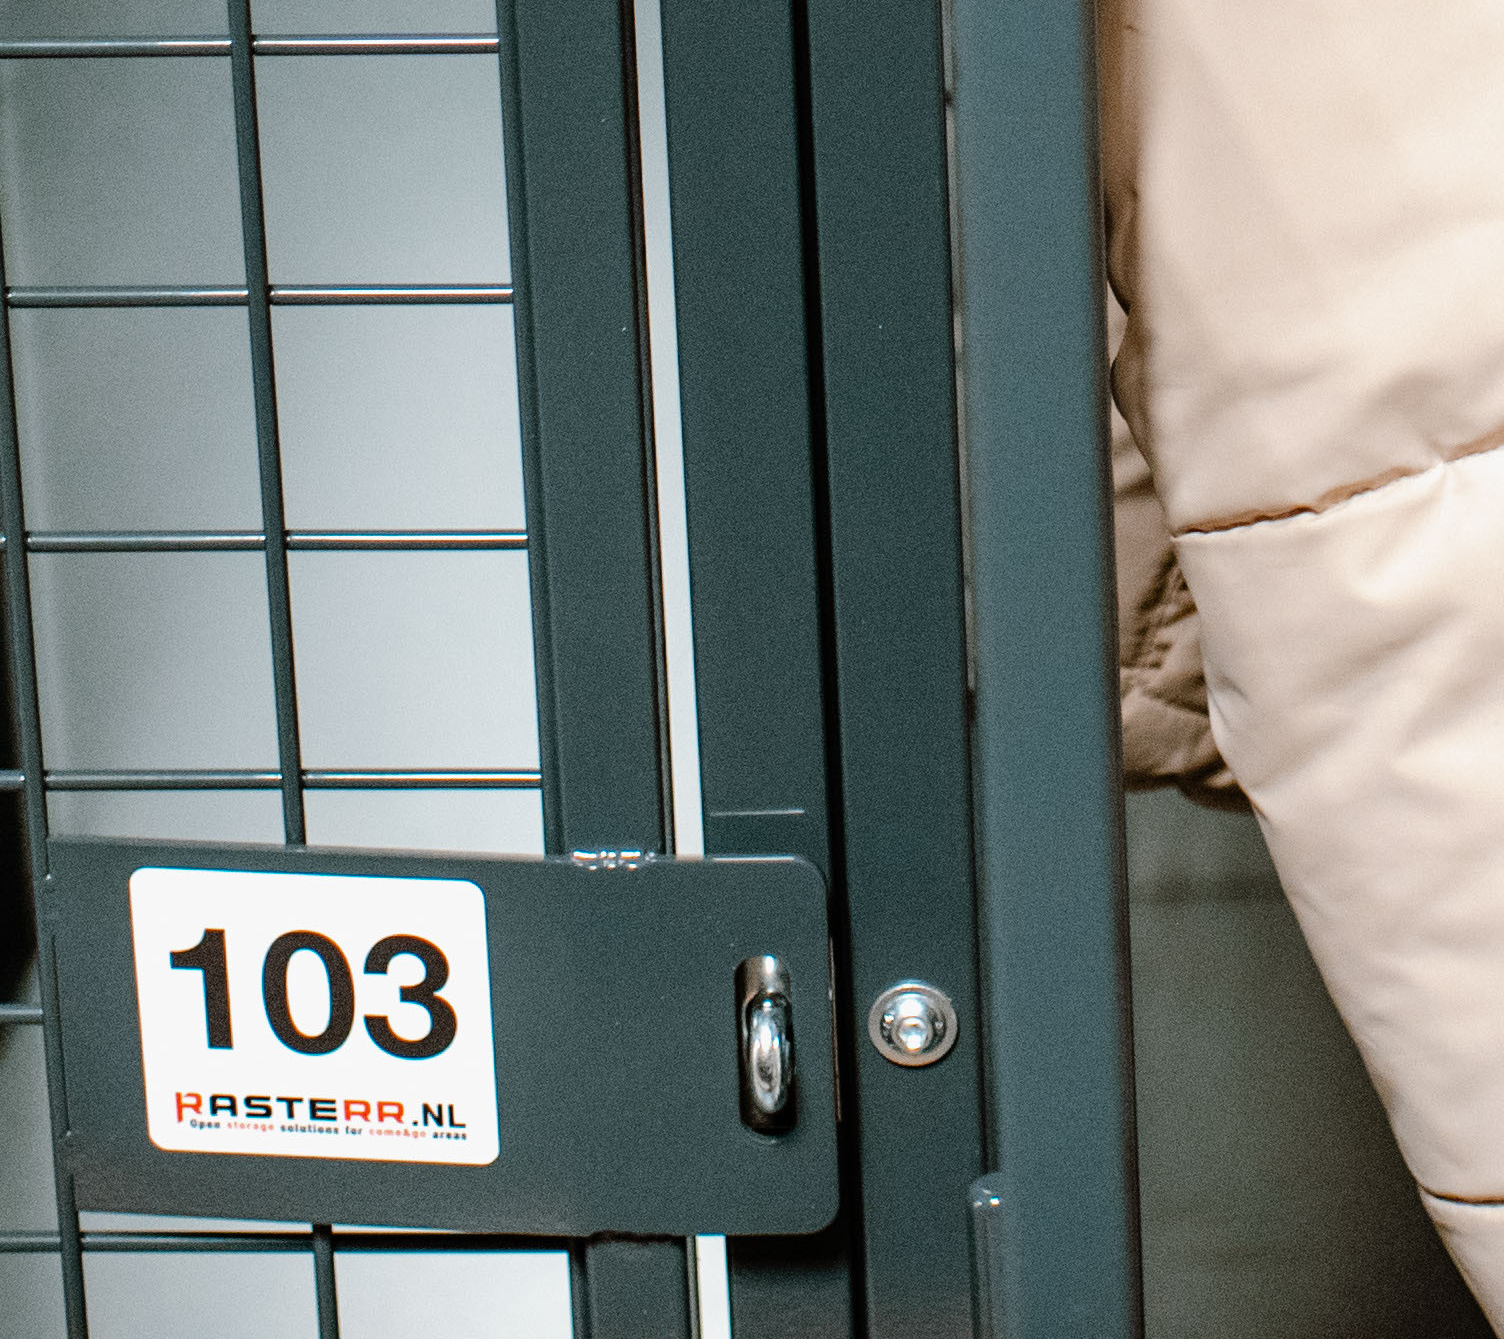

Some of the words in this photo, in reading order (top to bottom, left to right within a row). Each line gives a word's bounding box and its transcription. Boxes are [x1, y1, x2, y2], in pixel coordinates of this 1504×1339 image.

[168, 927, 459, 1062] 103
[175, 1091, 467, 1129] RASTERR.NL
[189, 1118, 221, 1130] Open
[227, 1119, 274, 1131] storage
[280, 1123, 339, 1135] solutions
[345, 1125, 363, 1136] for
[432, 1130, 468, 1140] areas
